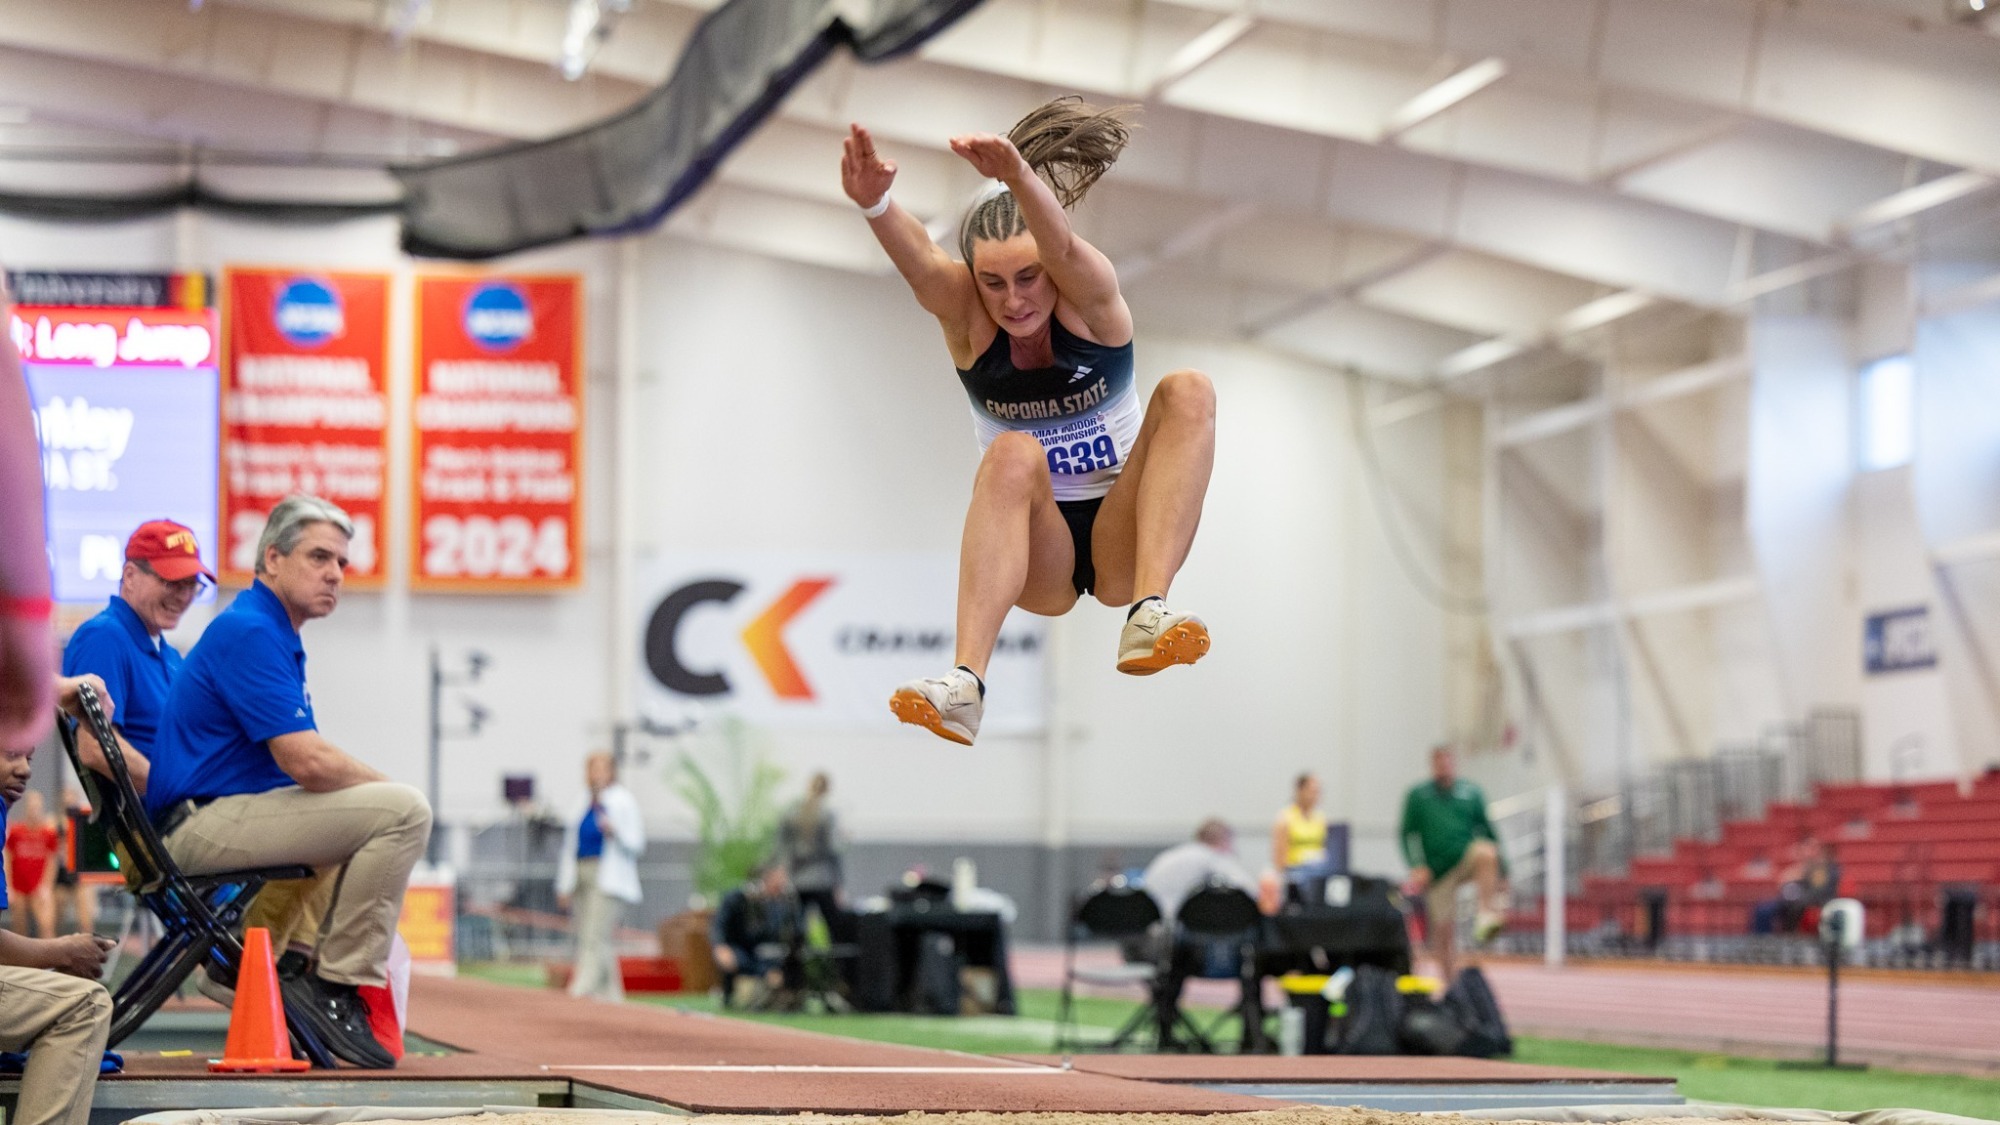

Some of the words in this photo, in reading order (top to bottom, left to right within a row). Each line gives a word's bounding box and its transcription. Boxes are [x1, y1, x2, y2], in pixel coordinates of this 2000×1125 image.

[35, 315, 117, 367] Long
[118, 317, 211, 369] Jump
[986, 399, 1062, 420] EMPORIA
[1063, 376, 1109, 415] STATE
[1032, 428, 1058, 439] MIAA
[1061, 417, 1097, 434] INDOOR
[1039, 423, 1106, 447] AMPIONSHIPS
[1047, 434, 1118, 475] 639
[424, 514, 571, 577] 2024
